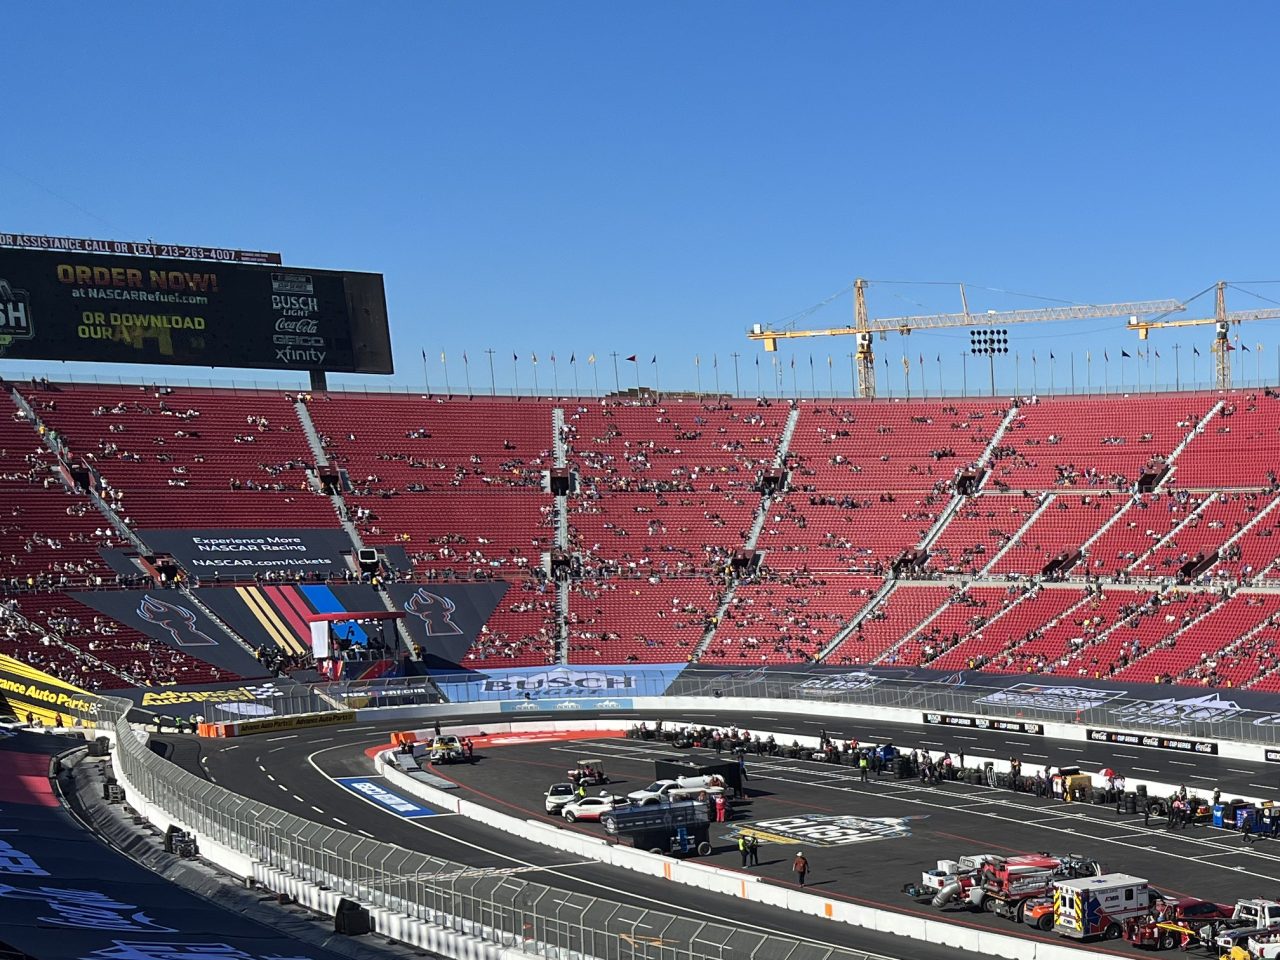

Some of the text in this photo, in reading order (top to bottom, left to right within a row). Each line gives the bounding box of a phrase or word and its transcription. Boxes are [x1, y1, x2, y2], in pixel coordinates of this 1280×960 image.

[0, 234, 12, 245] OR
[17, 235, 82, 250] ASSISTANCE
[85, 240, 111, 252] CALL
[114, 242, 128, 253] OR
[132, 243, 157, 255] TEXT
[57, 264, 218, 292] ORDER NOW!
[72, 288, 208, 305] at NASCARRefuel.com
[272, 295, 319, 312] BUSCH
[82, 311, 205, 330] OR DOWNLOAD
[283, 309, 309, 317] LIGHT
[77, 325, 113, 339] OUR
[273, 334, 324, 346] GEICO
[275, 345, 326, 364] xfinity
[193, 537, 264, 545] Experience
[192, 558, 332, 566] NASCAR.com/tickets
[484, 676, 633, 692] BUSCH
[25, 685, 57, 703] Auto
[57, 693, 89, 712] Parts
[756, 817, 884, 844] CLASH
